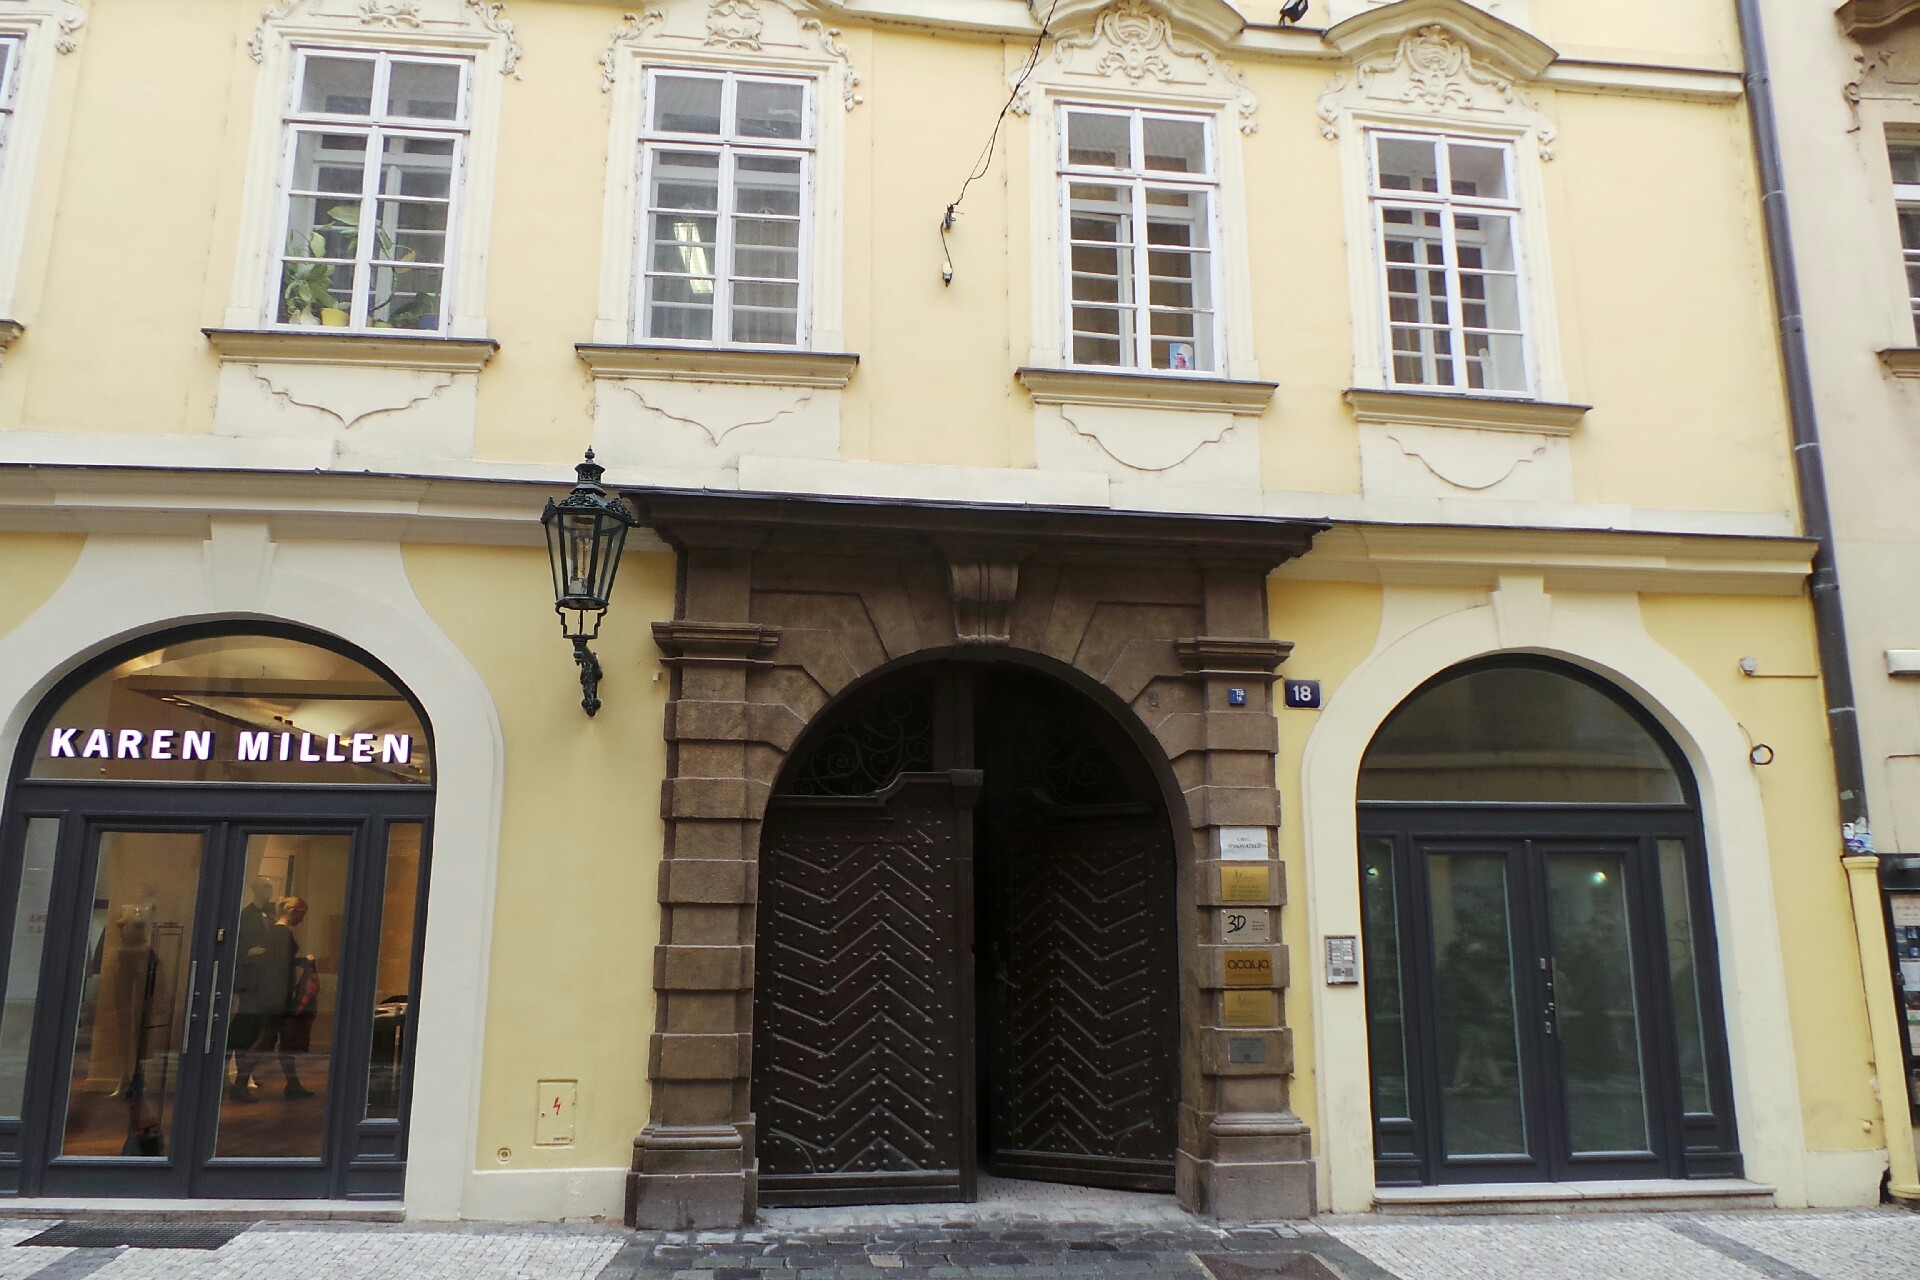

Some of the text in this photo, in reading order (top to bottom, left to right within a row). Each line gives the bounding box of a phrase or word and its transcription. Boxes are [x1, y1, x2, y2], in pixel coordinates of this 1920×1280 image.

[1293, 685, 1312, 702] 18
[50, 727, 412, 764] KAREN MILLEN
[1226, 914, 1246, 933] 3D
